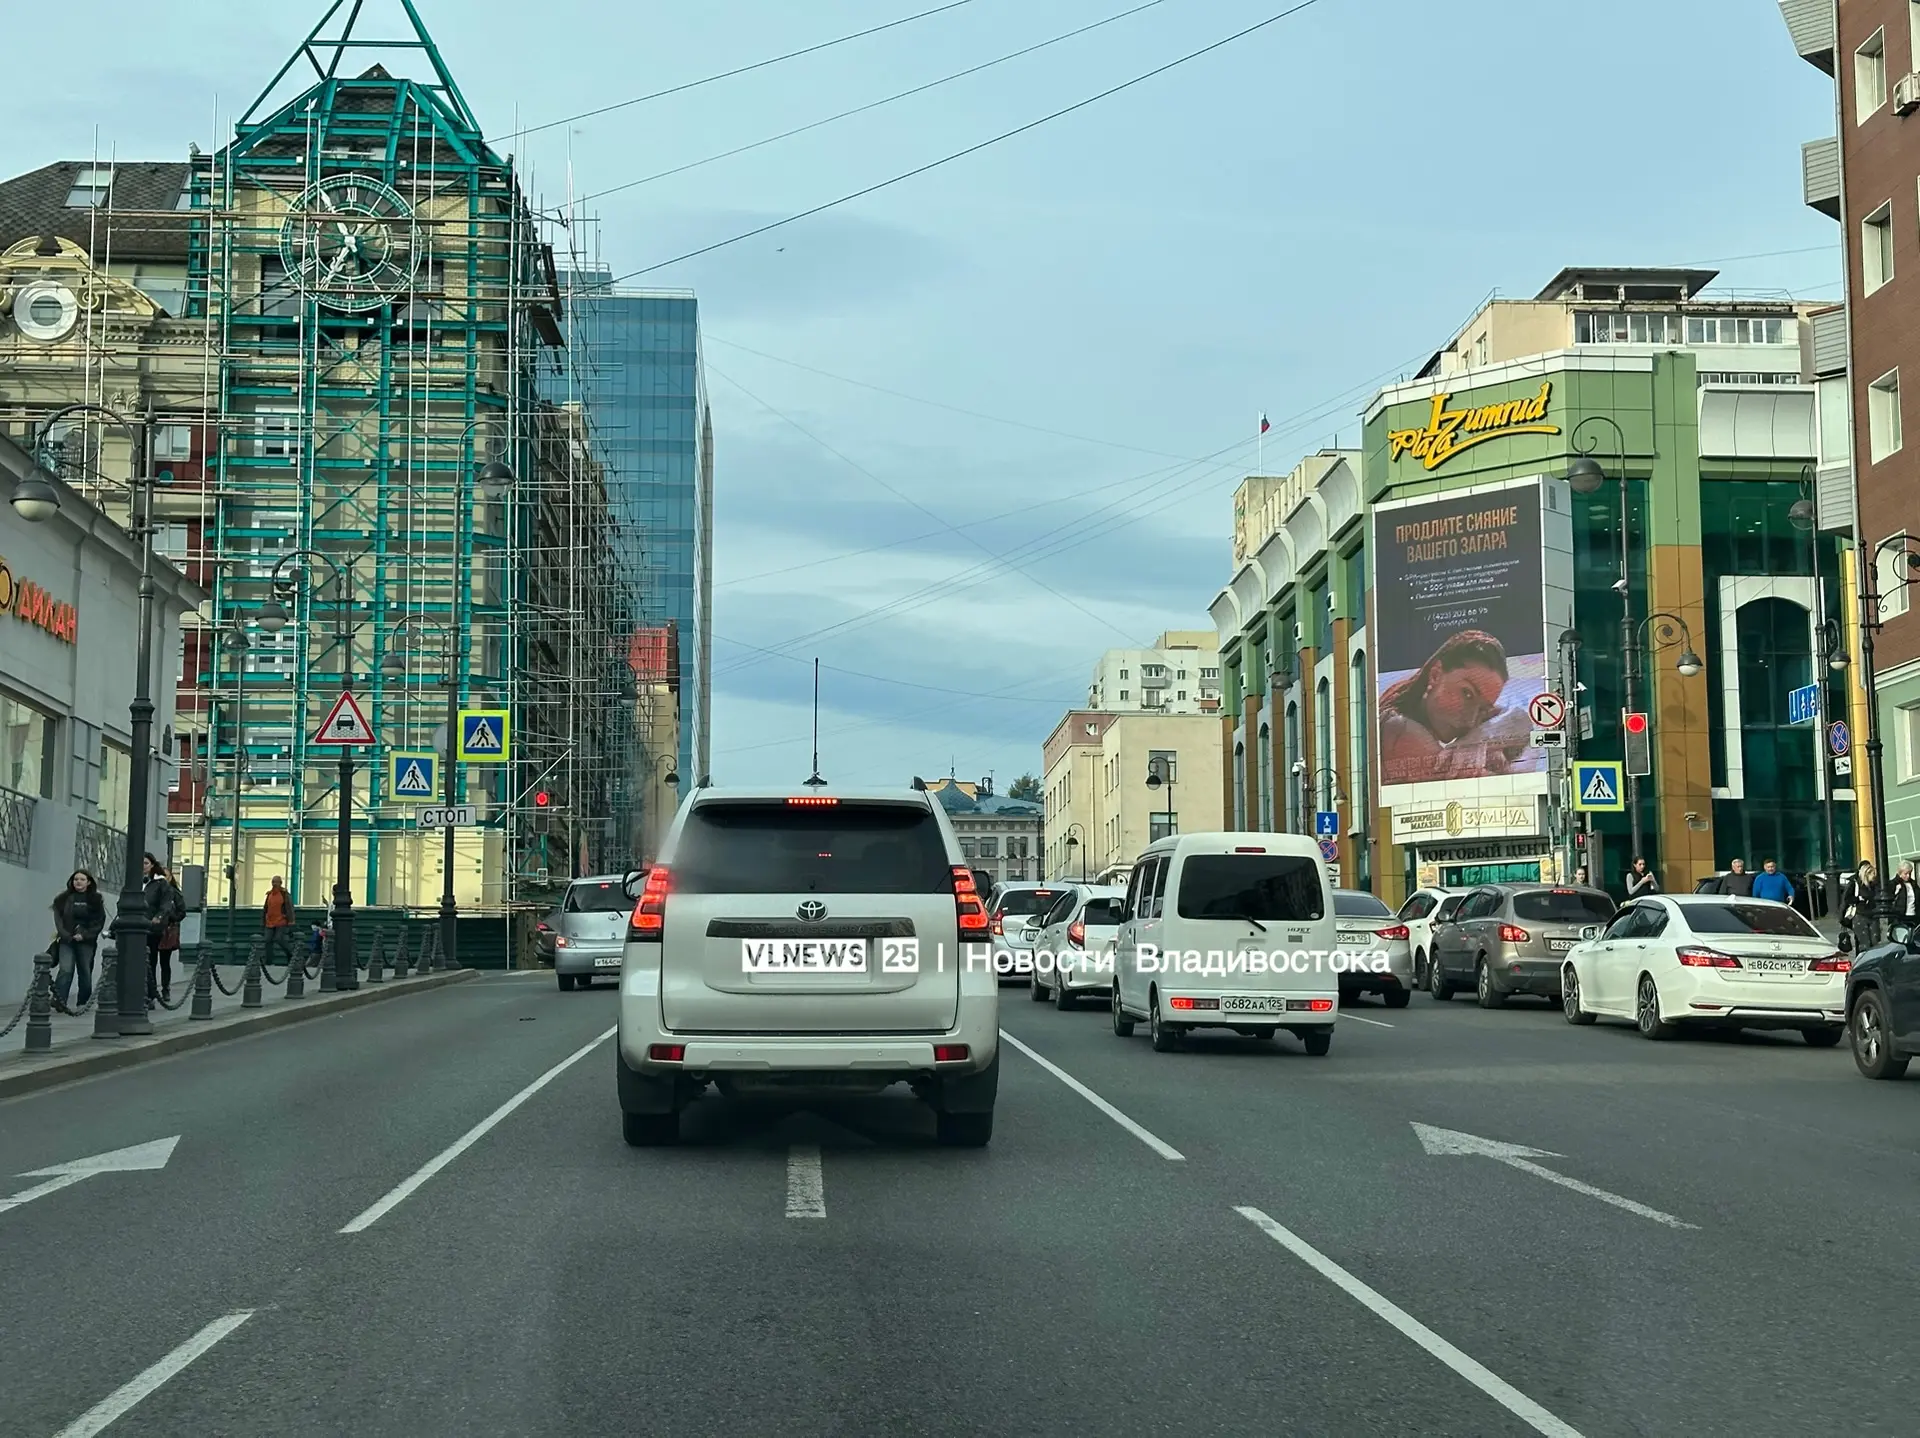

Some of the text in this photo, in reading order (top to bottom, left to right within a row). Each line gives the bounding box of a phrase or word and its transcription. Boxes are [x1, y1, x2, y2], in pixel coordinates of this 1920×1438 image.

[1395, 506, 1519, 544] ПРОДЛИТЕ СИЯНИЕ
[1406, 531, 1508, 564] ВАШЕГО ЗАГАРА
[16, 577, 77, 645] ДИЛАН
[423, 810, 467, 824] СТОП
[1419, 844, 1502, 863] ТОРГОВЫЙ
[1224, 999, 1283, 1010] О682АА 125
